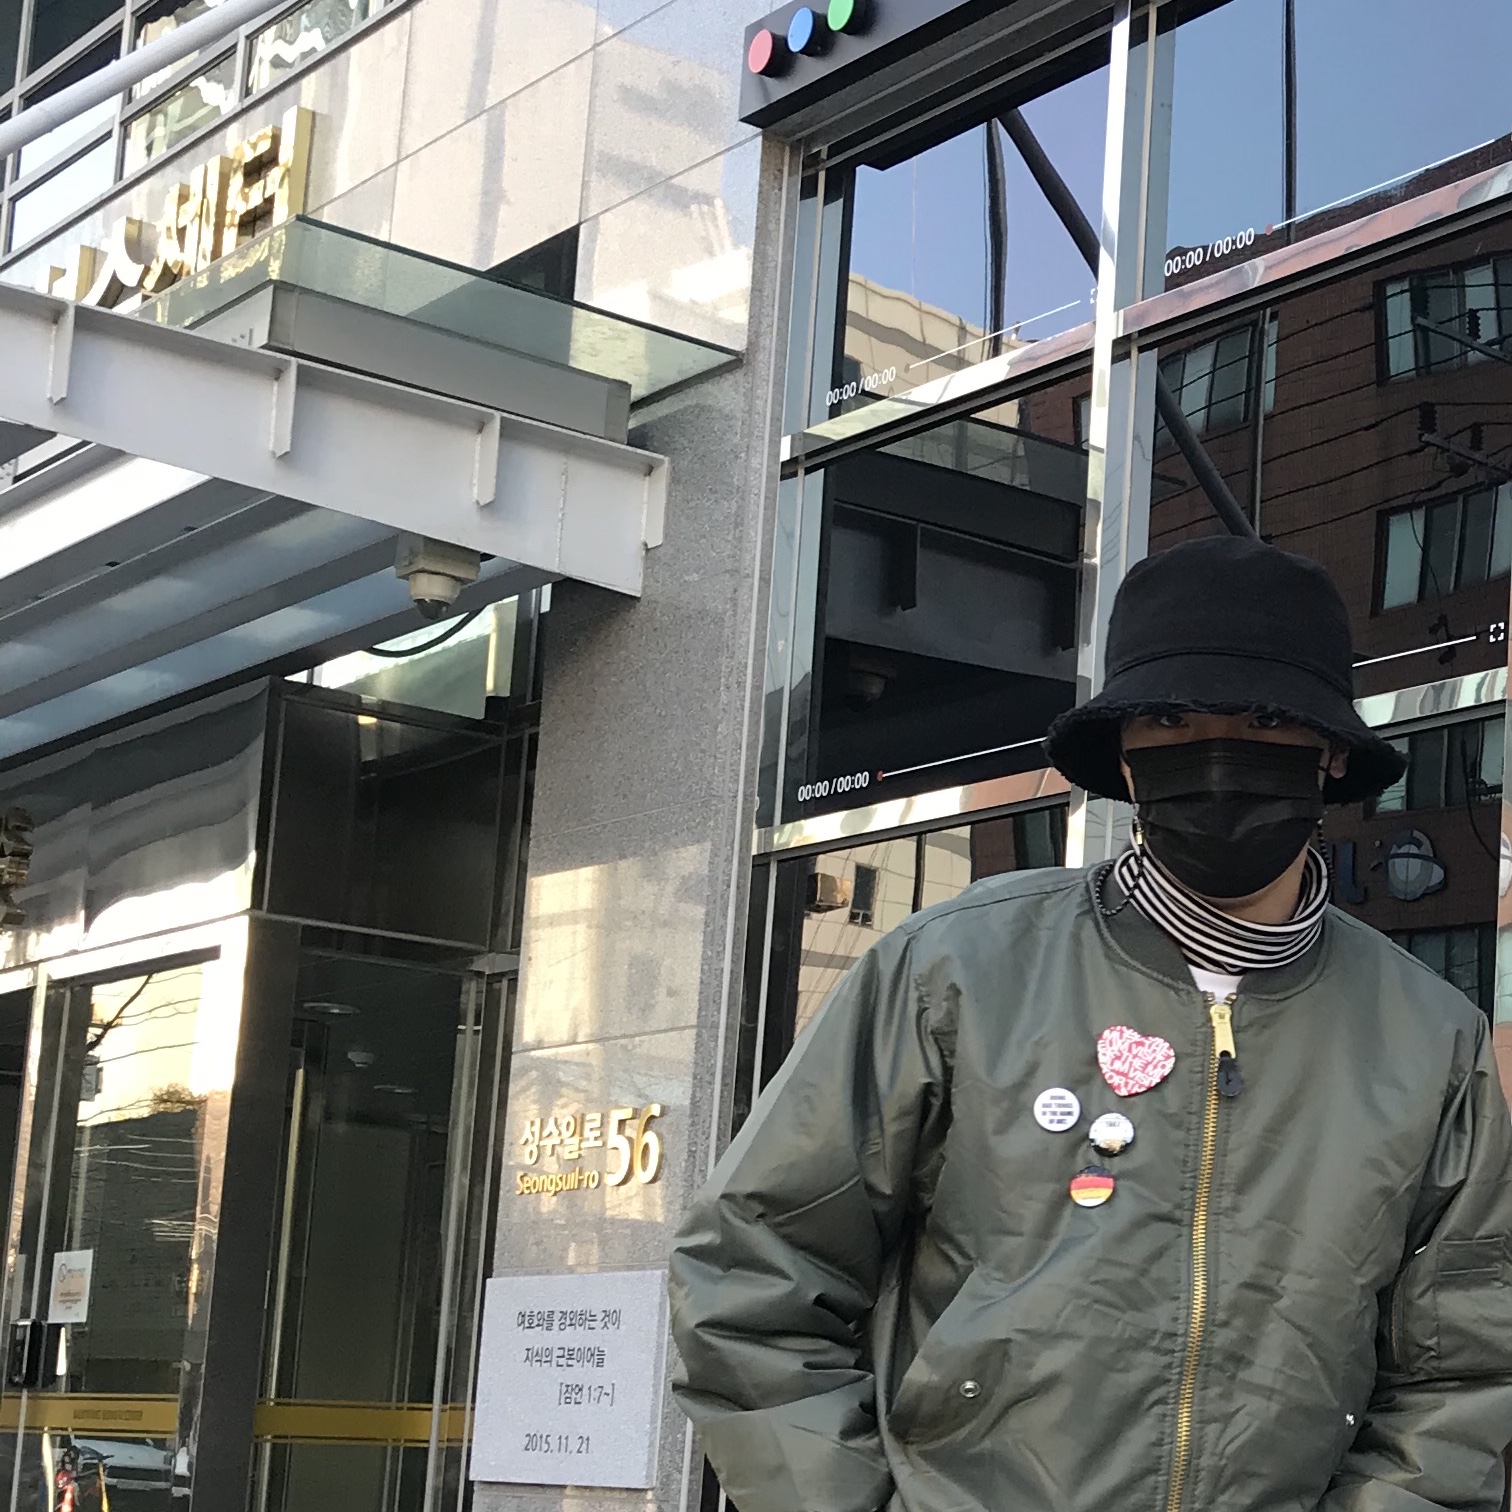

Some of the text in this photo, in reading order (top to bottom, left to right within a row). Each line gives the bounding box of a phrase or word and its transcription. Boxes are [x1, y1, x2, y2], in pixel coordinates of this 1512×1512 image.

[1164, 247, 1204, 277] 00:00
[1214, 227, 1255, 258] 00:00
[825, 381, 857, 407] 00:00
[864, 366, 896, 391] 00:00
[797, 780, 829, 802] 00:00
[837, 771, 869, 793] 00:00
[519, 1103, 662, 1187] 성수일로 56
[515, 1166, 599, 1196] Seongsuil-ro
[516, 1309, 621, 1331] 여호와를 경외하는 것이
[524, 1346, 606, 1368] 지식의 근본이어늘
[524, 1433, 554, 1454] 2015.
